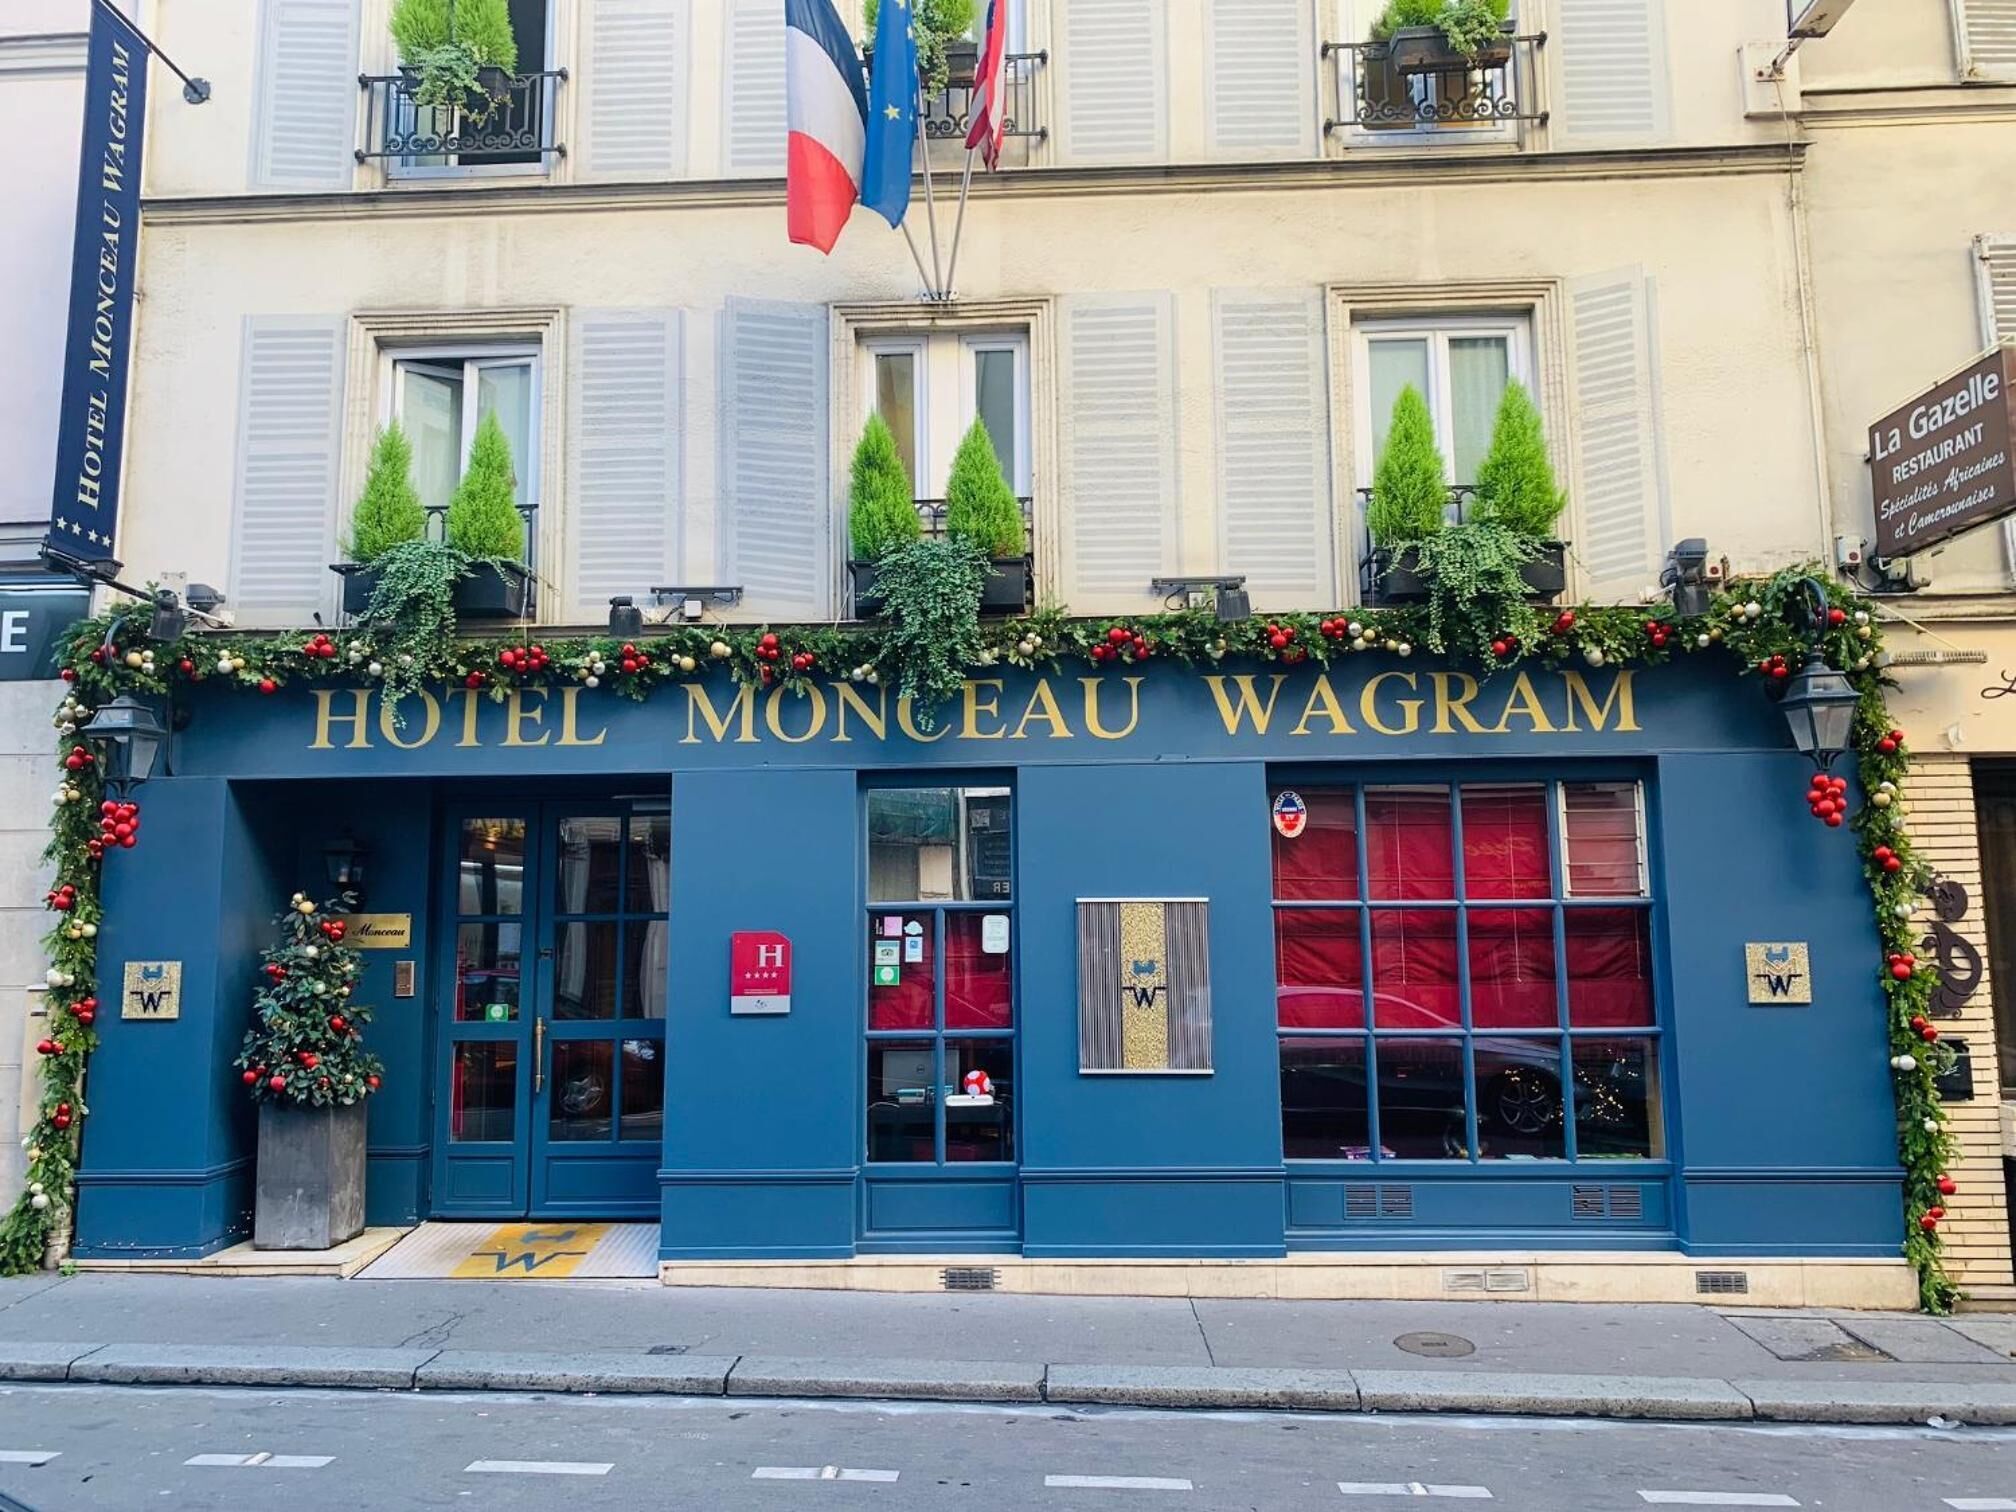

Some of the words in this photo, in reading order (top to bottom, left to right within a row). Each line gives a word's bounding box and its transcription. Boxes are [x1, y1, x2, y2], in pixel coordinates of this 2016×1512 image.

[103, 42, 131, 191] WAGRAM
[89, 203, 122, 378] MONCEAU
[77, 391, 110, 510] HOTEL
[1874, 427, 1901, 461] La
[1908, 373, 1999, 440] Gazelle
[1892, 422, 1984, 485] RESTAURANT
[1942, 451, 2006, 493] Africaines
[1894, 522, 1905, 540] et
[1908, 485, 1996, 537] Camerounaises
[308, 685, 607, 749] HOTEL
[680, 677, 1144, 743] MONCEAU
[1203, 670, 1644, 737] WAGRAM
[352, 923, 406, 936] Monceau
[756, 944, 785, 967] H
